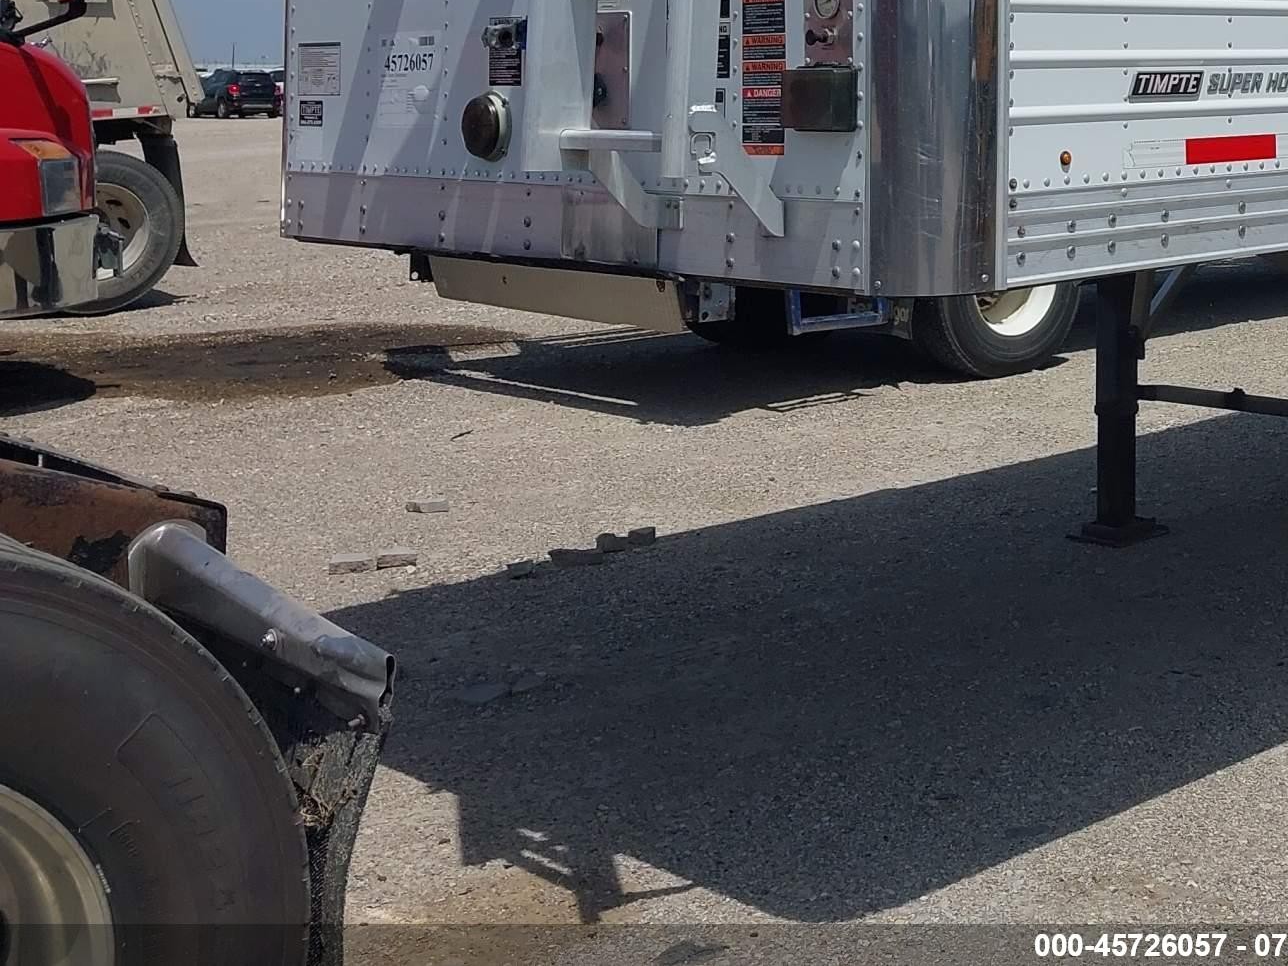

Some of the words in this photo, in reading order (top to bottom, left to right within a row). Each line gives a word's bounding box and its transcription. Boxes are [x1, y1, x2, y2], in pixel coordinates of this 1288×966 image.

[384, 53, 434, 72] 45726057
[1138, 73, 1201, 95] TIMPTE
[1207, 72, 1264, 95] SUPER
